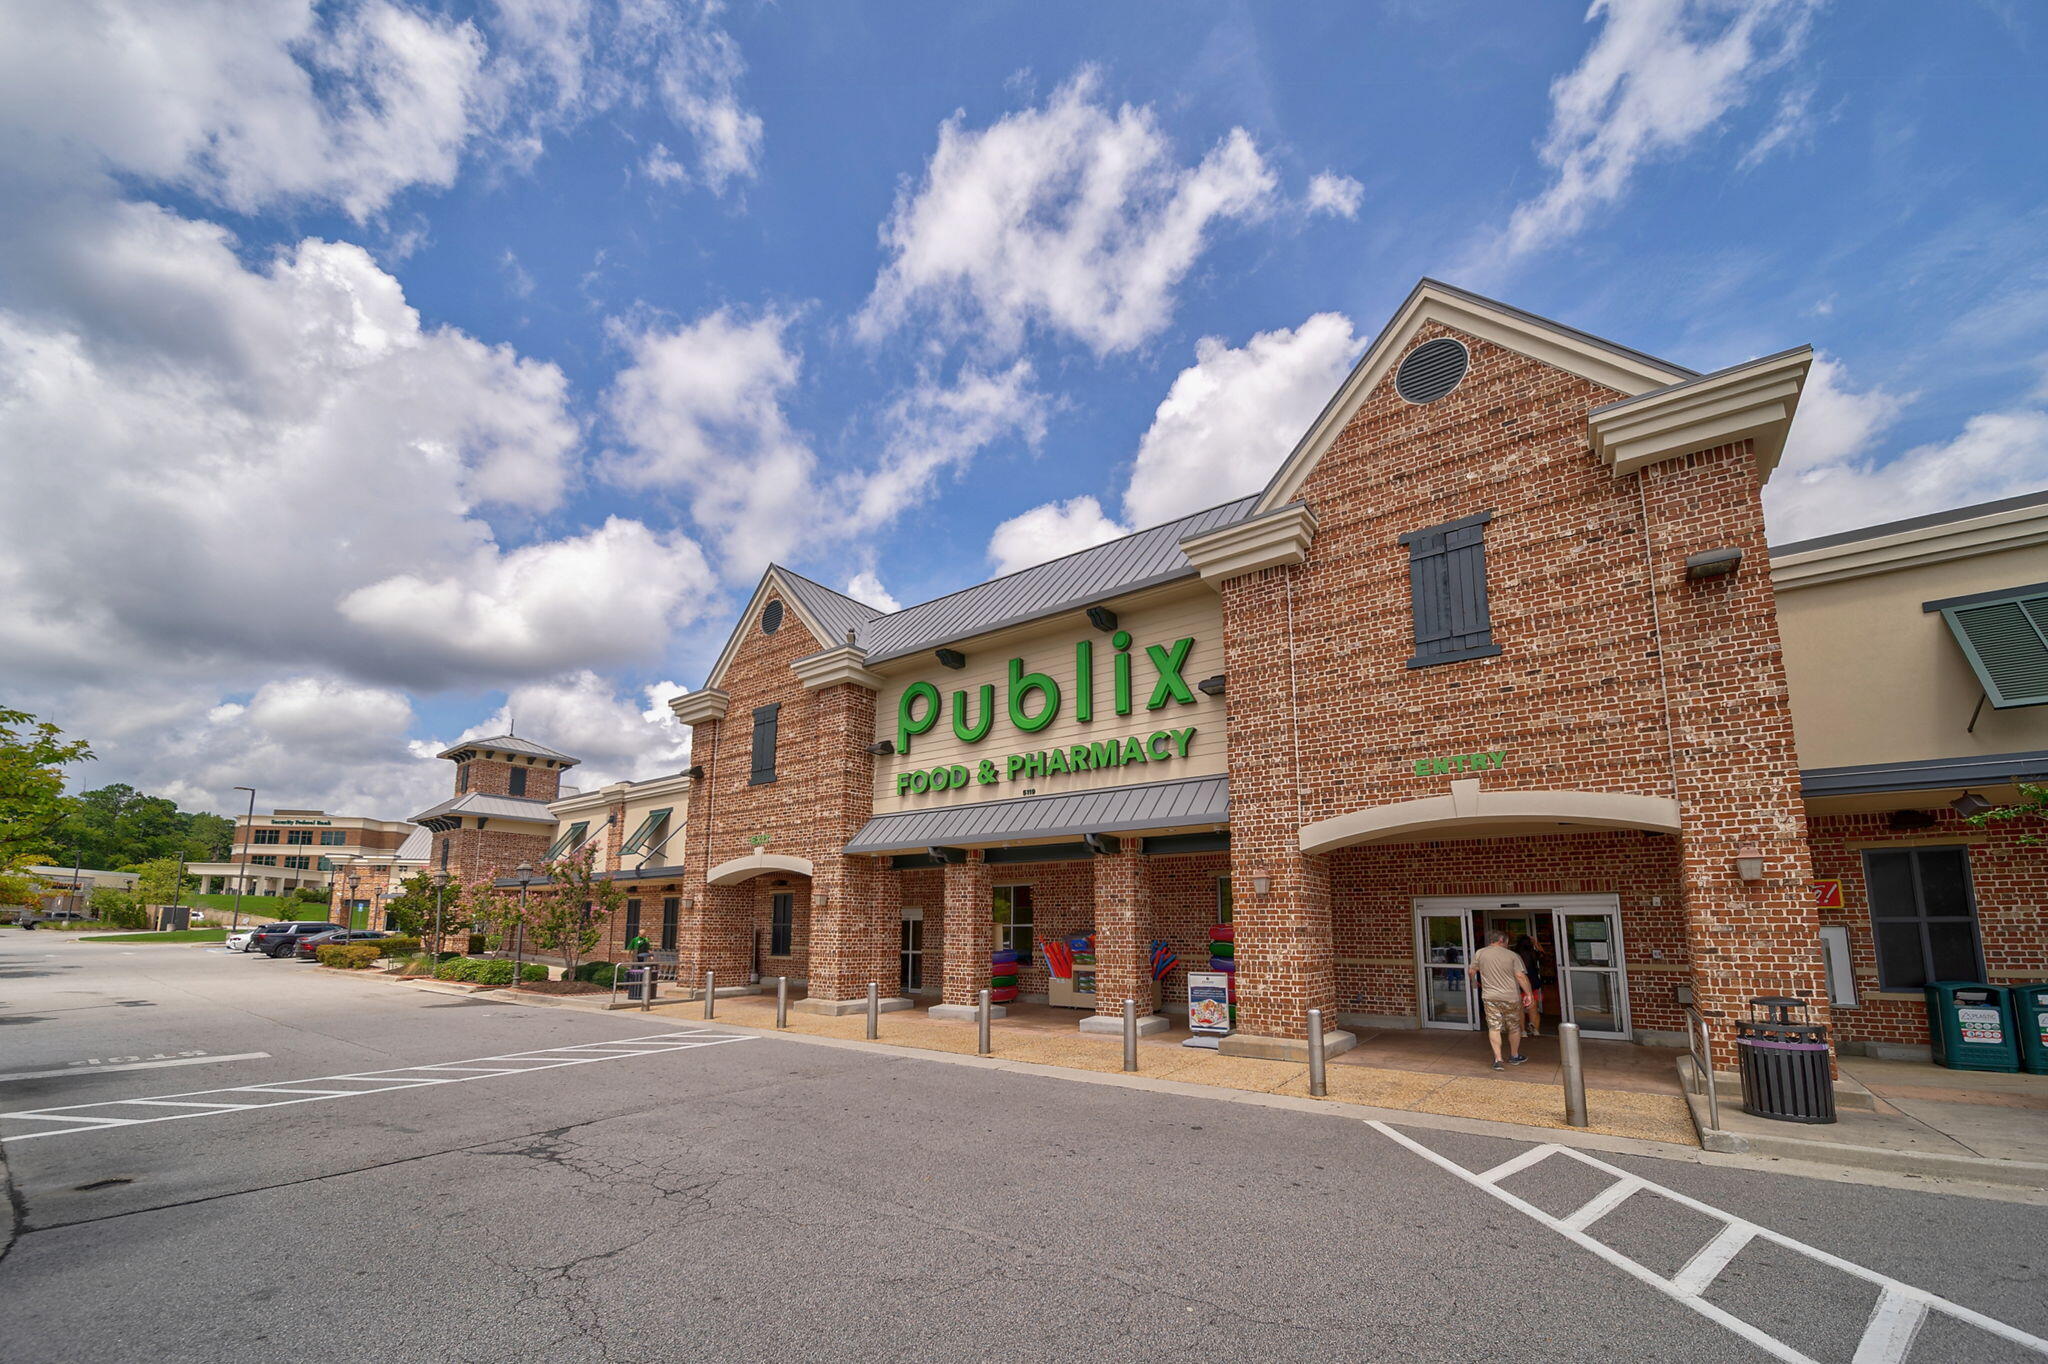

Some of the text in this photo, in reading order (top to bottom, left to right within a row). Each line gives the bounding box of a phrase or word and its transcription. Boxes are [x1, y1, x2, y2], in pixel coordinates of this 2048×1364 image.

[897, 727, 1197, 796] FOOD & PHARMACY
[1415, 751, 1507, 777] ENTRY
[68, 1049, 208, 1066] STOP
